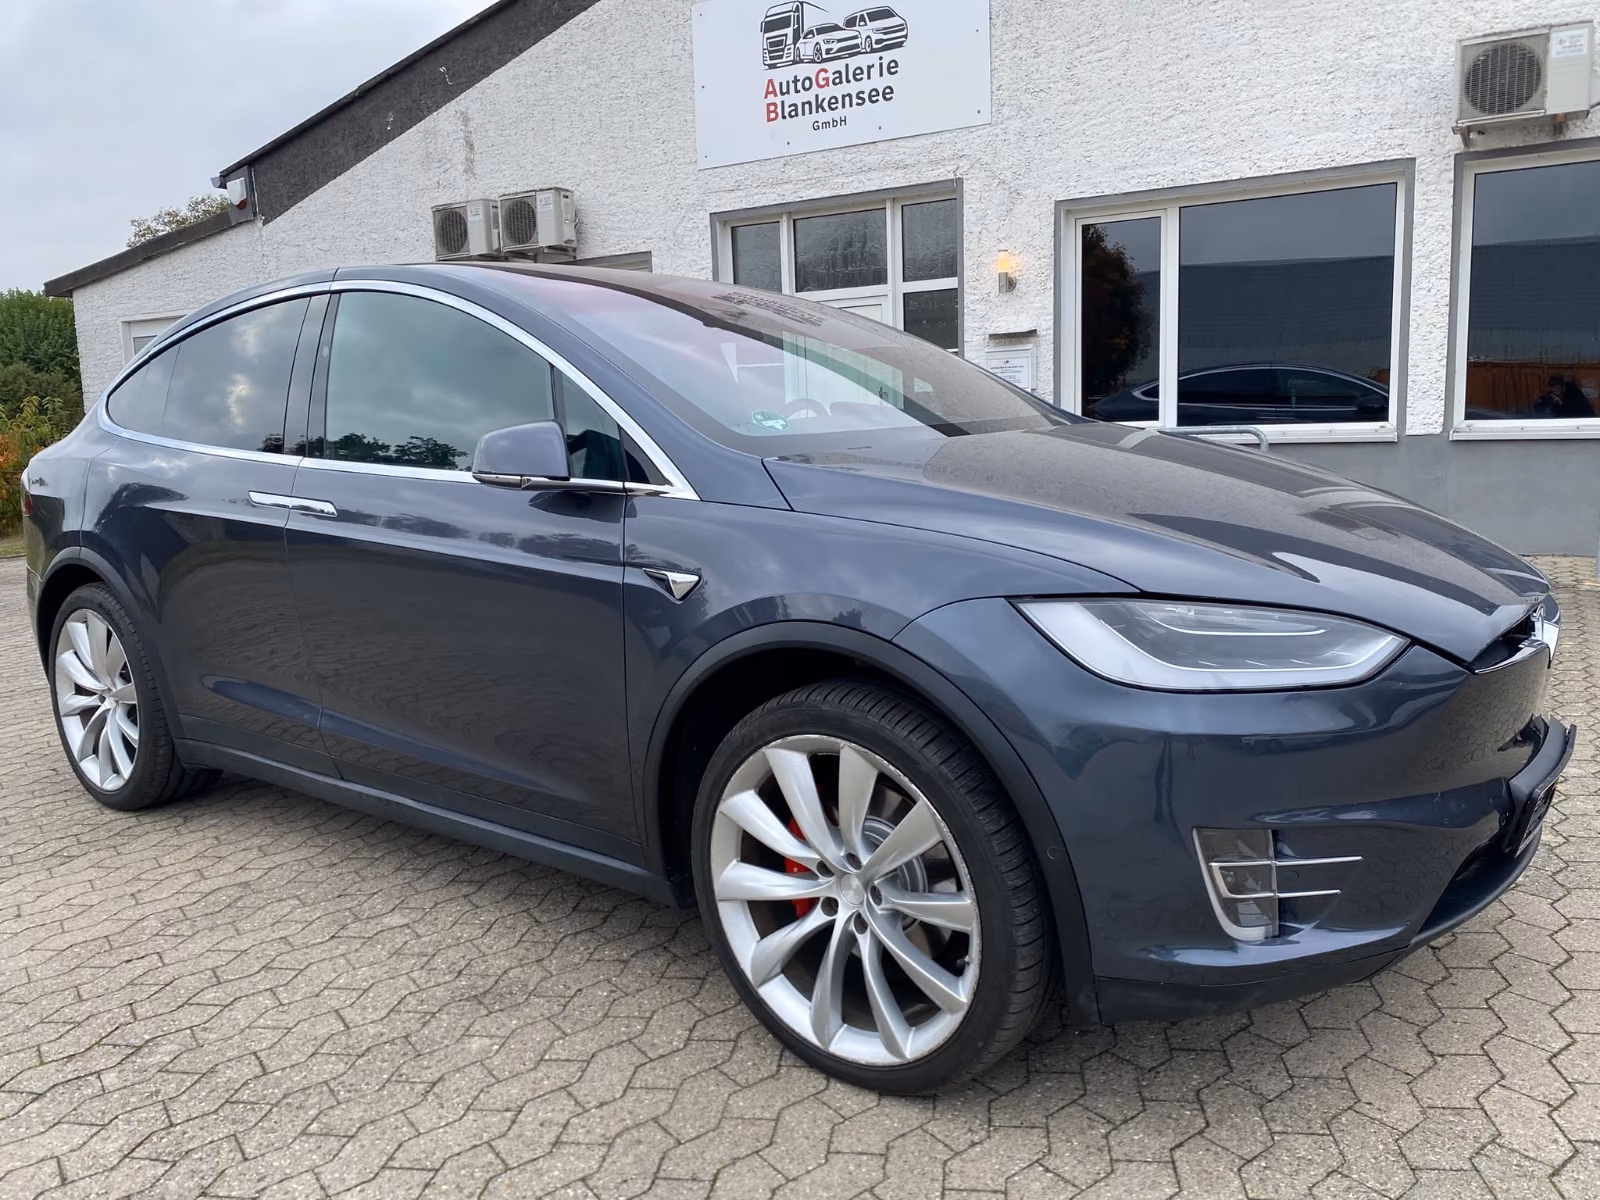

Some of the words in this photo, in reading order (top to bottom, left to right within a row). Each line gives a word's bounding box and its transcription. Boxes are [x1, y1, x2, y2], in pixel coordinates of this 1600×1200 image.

[764, 56, 899, 99] AutoGalerie
[766, 85, 894, 122] Blankensee
[812, 116, 847, 131] GmbH
